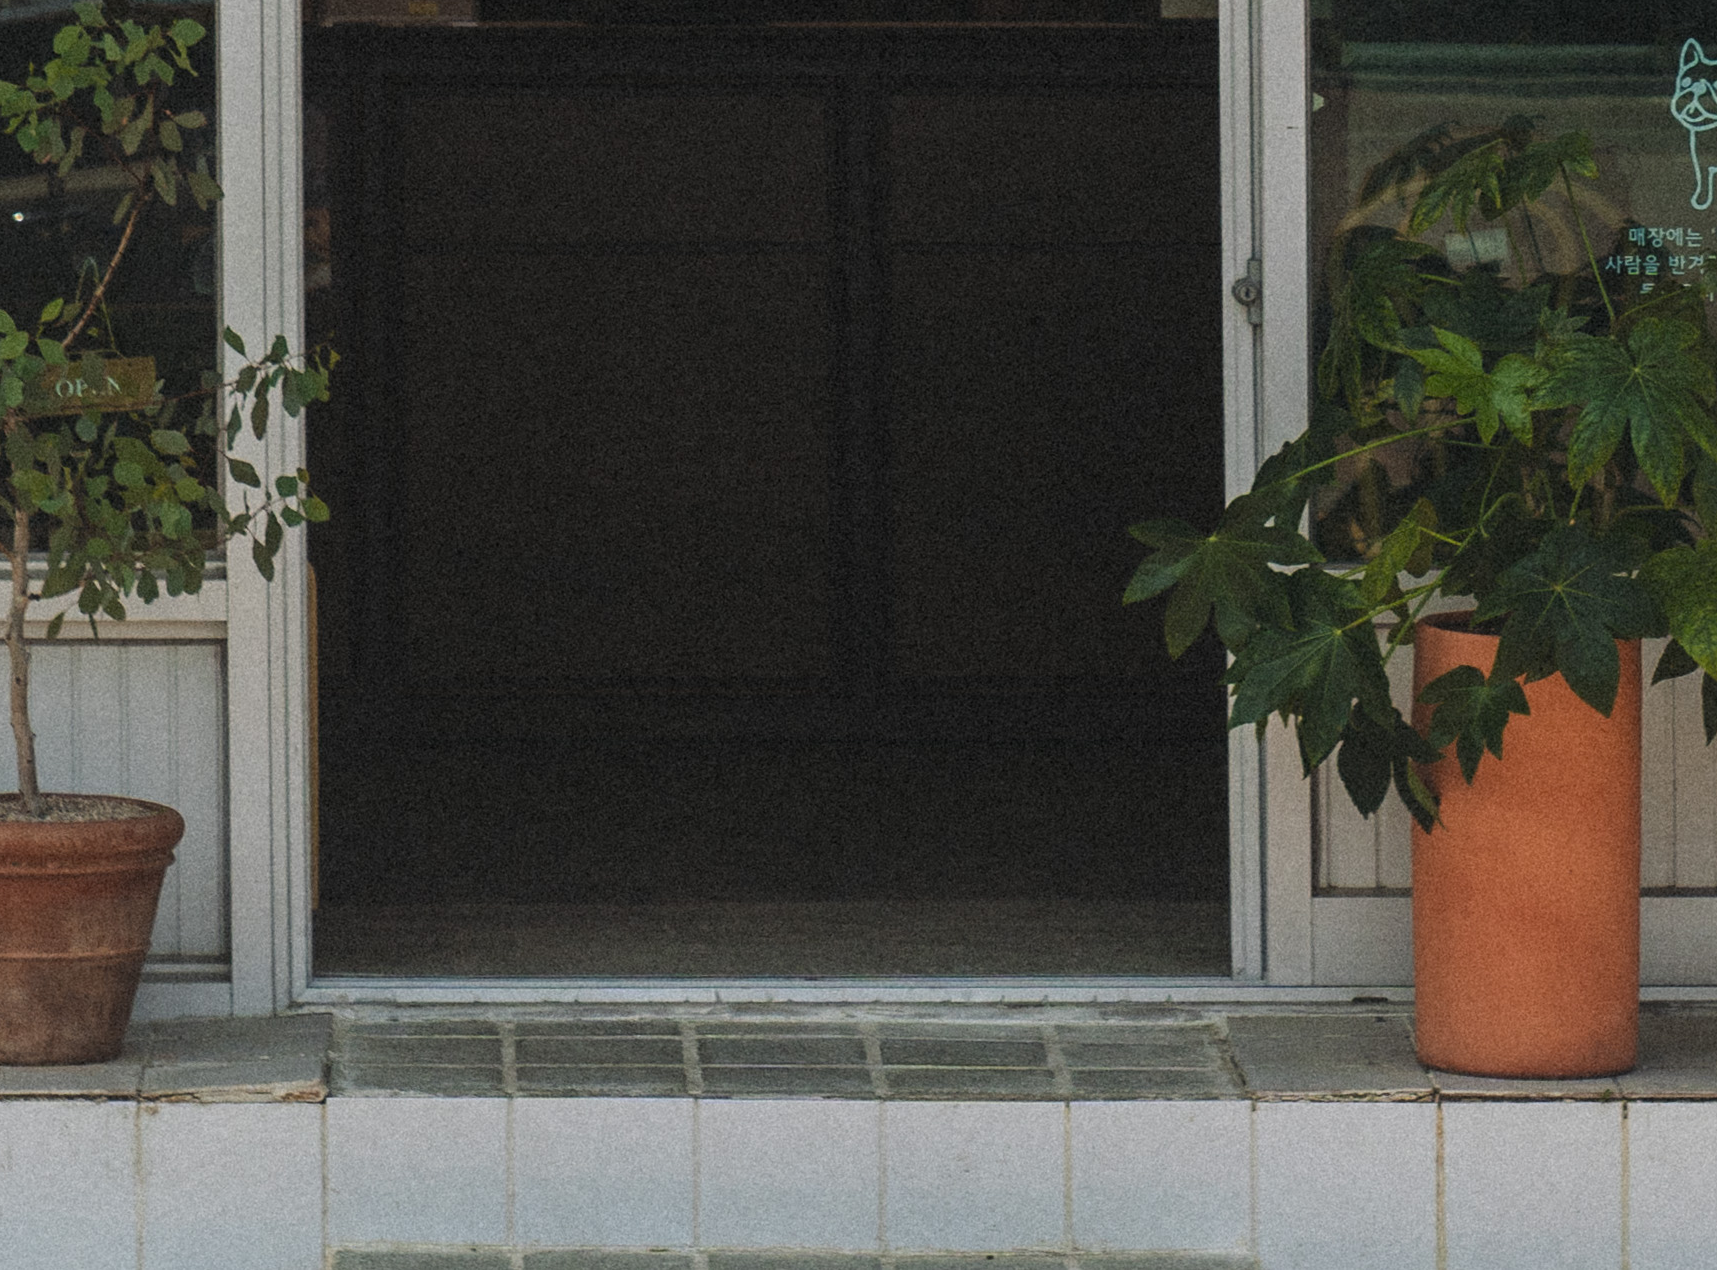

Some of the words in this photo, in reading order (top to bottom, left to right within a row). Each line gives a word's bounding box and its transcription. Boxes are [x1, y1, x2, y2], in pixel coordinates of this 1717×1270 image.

[1628, 226, 1704, 248] 매장에는
[1605, 255, 1661, 276] 사람을
[55, 376, 122, 398] OPN
